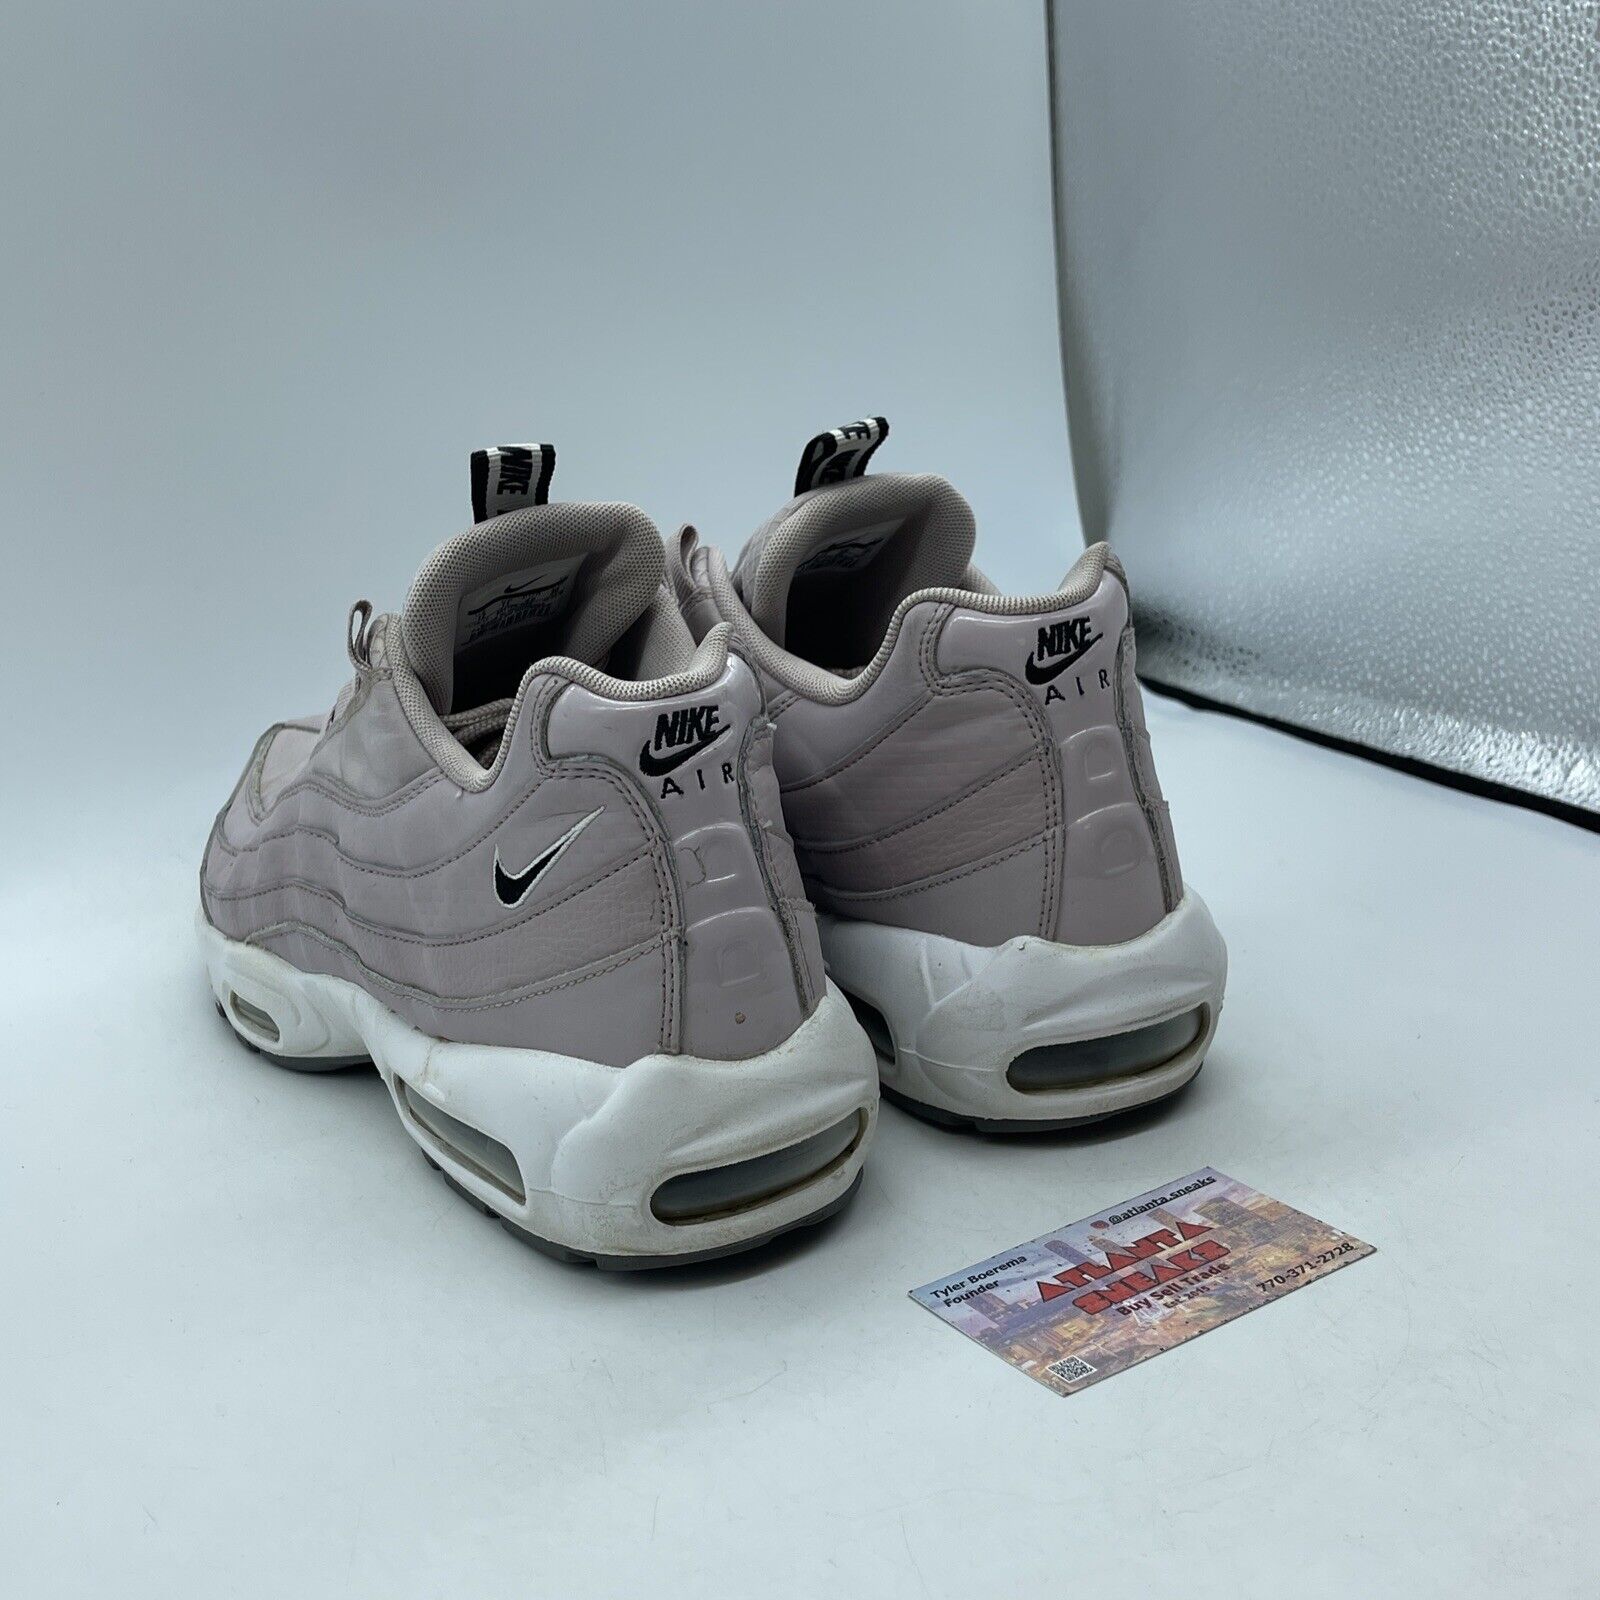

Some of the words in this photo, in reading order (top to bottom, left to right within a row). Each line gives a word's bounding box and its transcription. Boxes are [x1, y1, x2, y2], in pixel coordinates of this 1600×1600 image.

[1037, 615, 1092, 661] NIKE
[1045, 668, 1110, 705] AIR
[654, 704, 720, 751] NIKE
[660, 762, 735, 799] AIR
[1108, 1175, 1217, 1225] @atlanta.sneaks
[930, 1280, 966, 1298] Tyler
[967, 1255, 1027, 1284] Boerema
[1036, 1221, 1214, 1303] ATLANTA
[1072, 1239, 1231, 1315] SNEAKS
[1256, 1242, 1354, 1292] 770-371-2728
[943, 1280, 999, 1307] Founder
[1116, 1297, 1152, 1315] Buy
[1150, 1282, 1184, 1301] Sell
[1180, 1263, 1230, 1286] Trade
